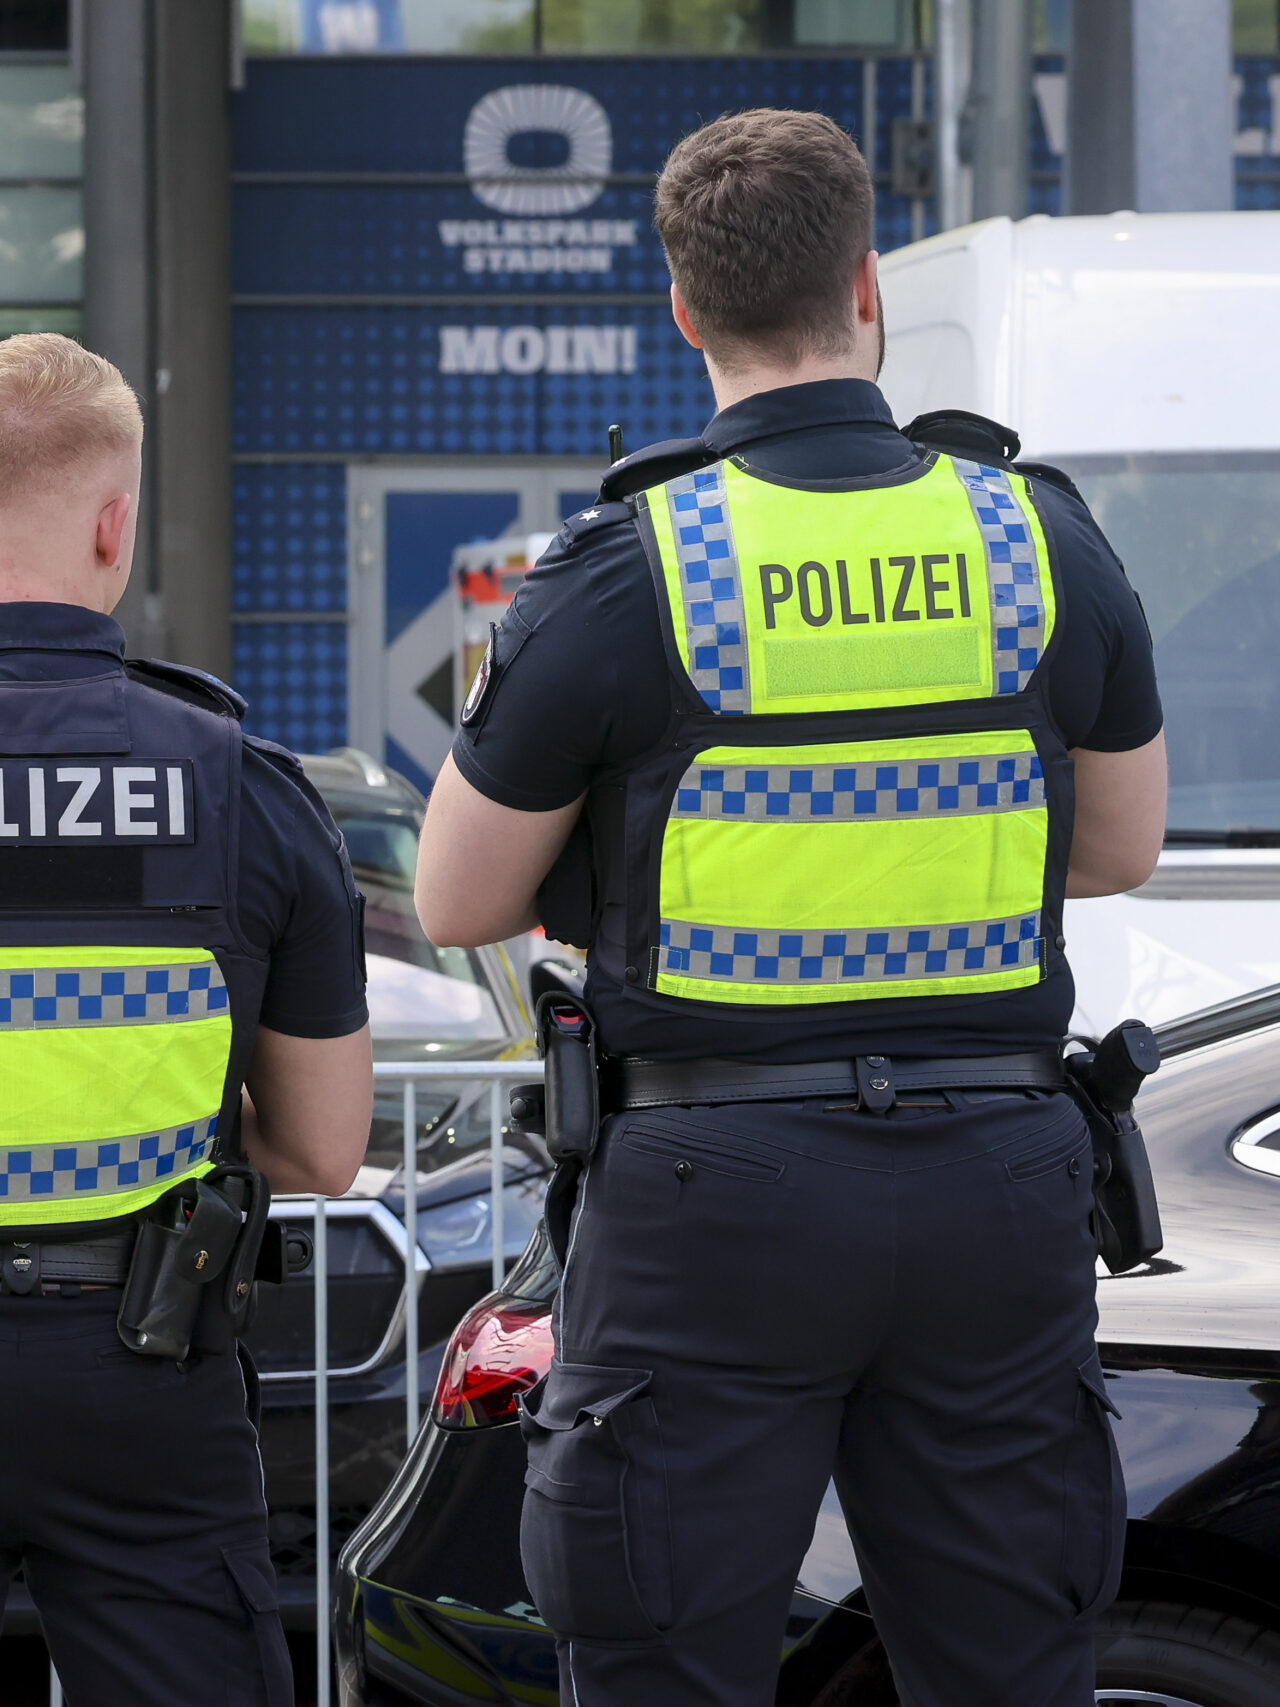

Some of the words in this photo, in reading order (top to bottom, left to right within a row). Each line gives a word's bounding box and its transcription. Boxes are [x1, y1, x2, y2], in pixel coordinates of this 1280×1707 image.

[439, 220, 637, 246] VOLKSPARK
[464, 248, 612, 273] STADION
[439, 325, 637, 375] MOIN!
[759, 553, 971, 630] POLIZEI
